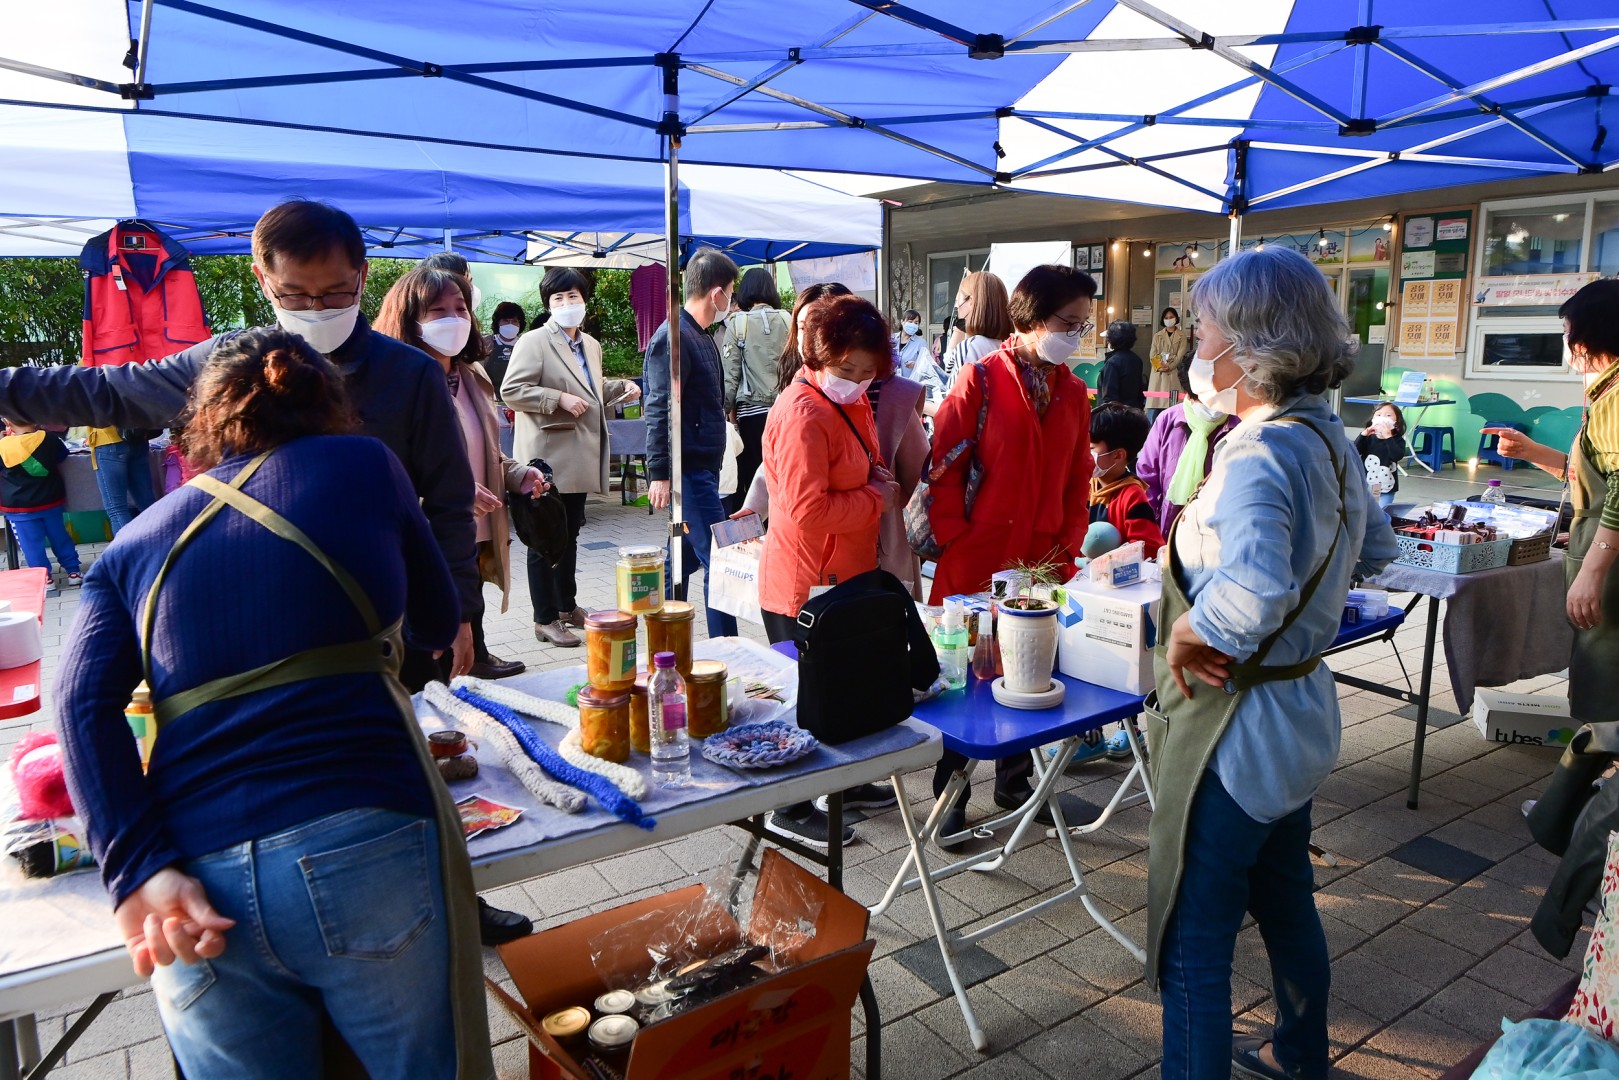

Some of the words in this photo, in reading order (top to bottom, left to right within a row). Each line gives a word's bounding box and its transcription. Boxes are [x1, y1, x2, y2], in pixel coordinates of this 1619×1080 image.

[724, 566, 755, 582] PHILIPS
[1112, 609, 1133, 618] SAMSUNG
[1495, 728, 1543, 746] tubes
